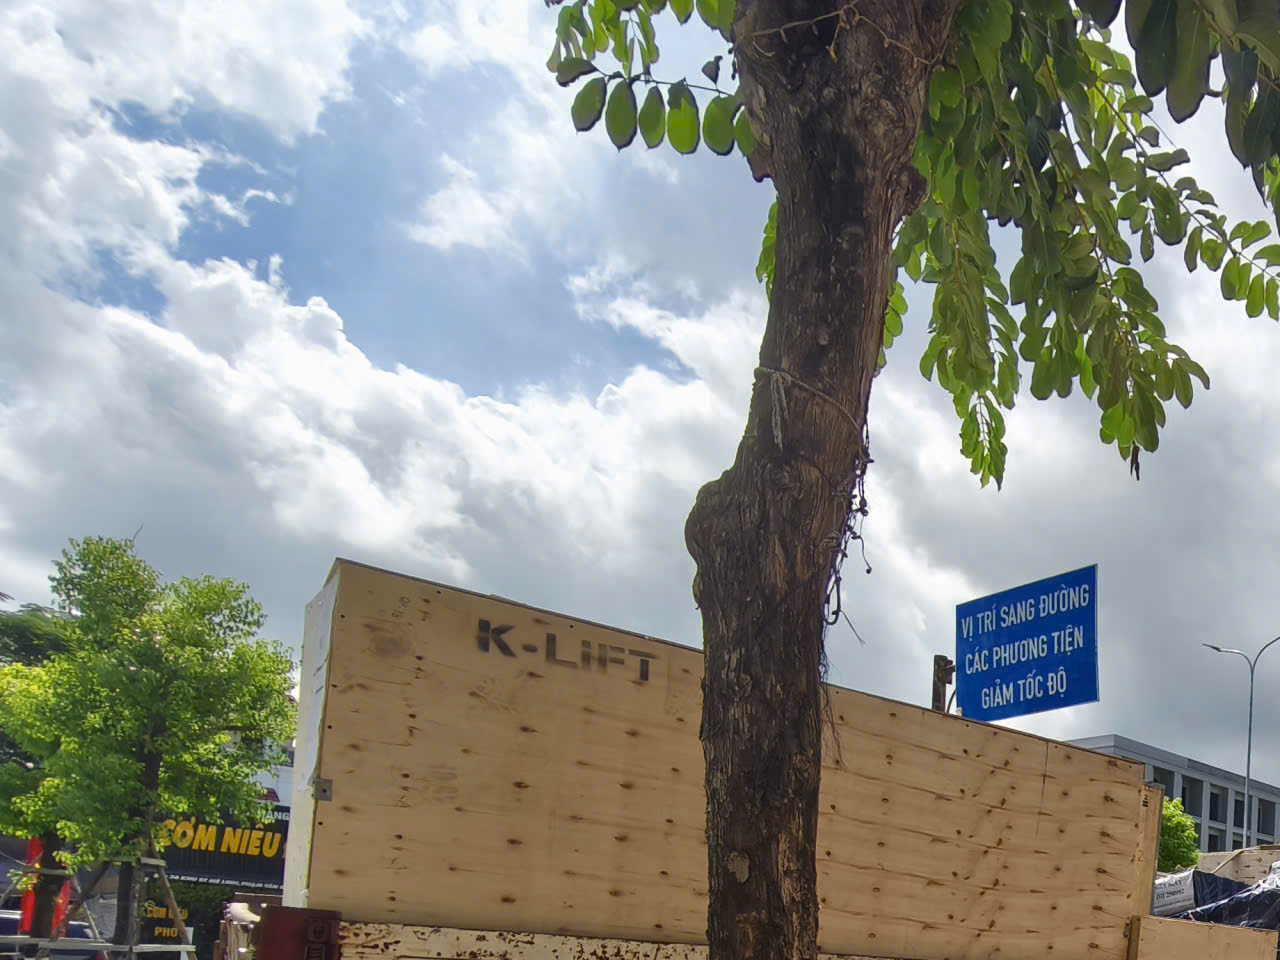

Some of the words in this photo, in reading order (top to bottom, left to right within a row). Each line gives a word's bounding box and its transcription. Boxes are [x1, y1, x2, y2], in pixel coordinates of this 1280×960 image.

[961, 616, 973, 642] VỊ
[977, 603, 996, 634] TRÍ
[1000, 598, 1035, 628] SANG
[1039, 584, 1089, 617] ĐƯỜNG
[477, 618, 661, 681] K-LIFT
[965, 646, 989, 675] CÁC
[993, 635, 1048, 669] PHƯƠNG
[1052, 624, 1084, 656] TIỆN
[981, 679, 1014, 709] GIẢM
[1017, 669, 1044, 702] TỐC
[1047, 666, 1067, 698] ĐỘ
[220, 823, 282, 858] NIÊU
